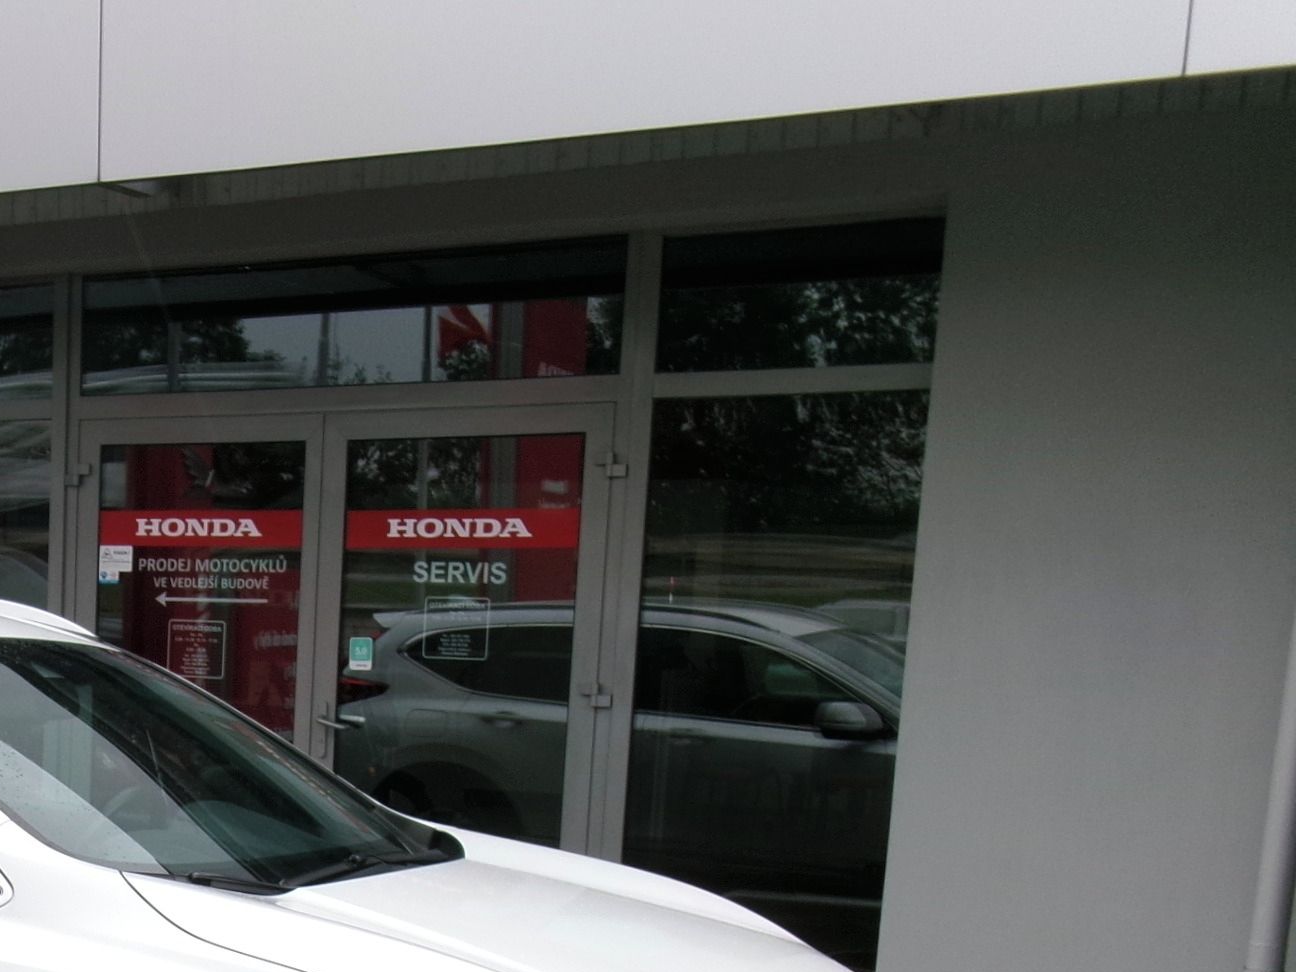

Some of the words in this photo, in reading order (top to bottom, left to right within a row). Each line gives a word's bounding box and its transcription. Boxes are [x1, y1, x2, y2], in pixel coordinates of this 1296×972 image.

[135, 518, 263, 537] HONDA
[387, 518, 533, 538] HONDA
[138, 558, 191, 572] PRODEJ
[195, 555, 288, 573] MOTOCYKLŮ
[412, 561, 507, 584] SERVIS
[154, 576, 167, 588] VE
[170, 575, 218, 589] VEDLEJŠÍ
[221, 576, 270, 590] BUDOVĚ
